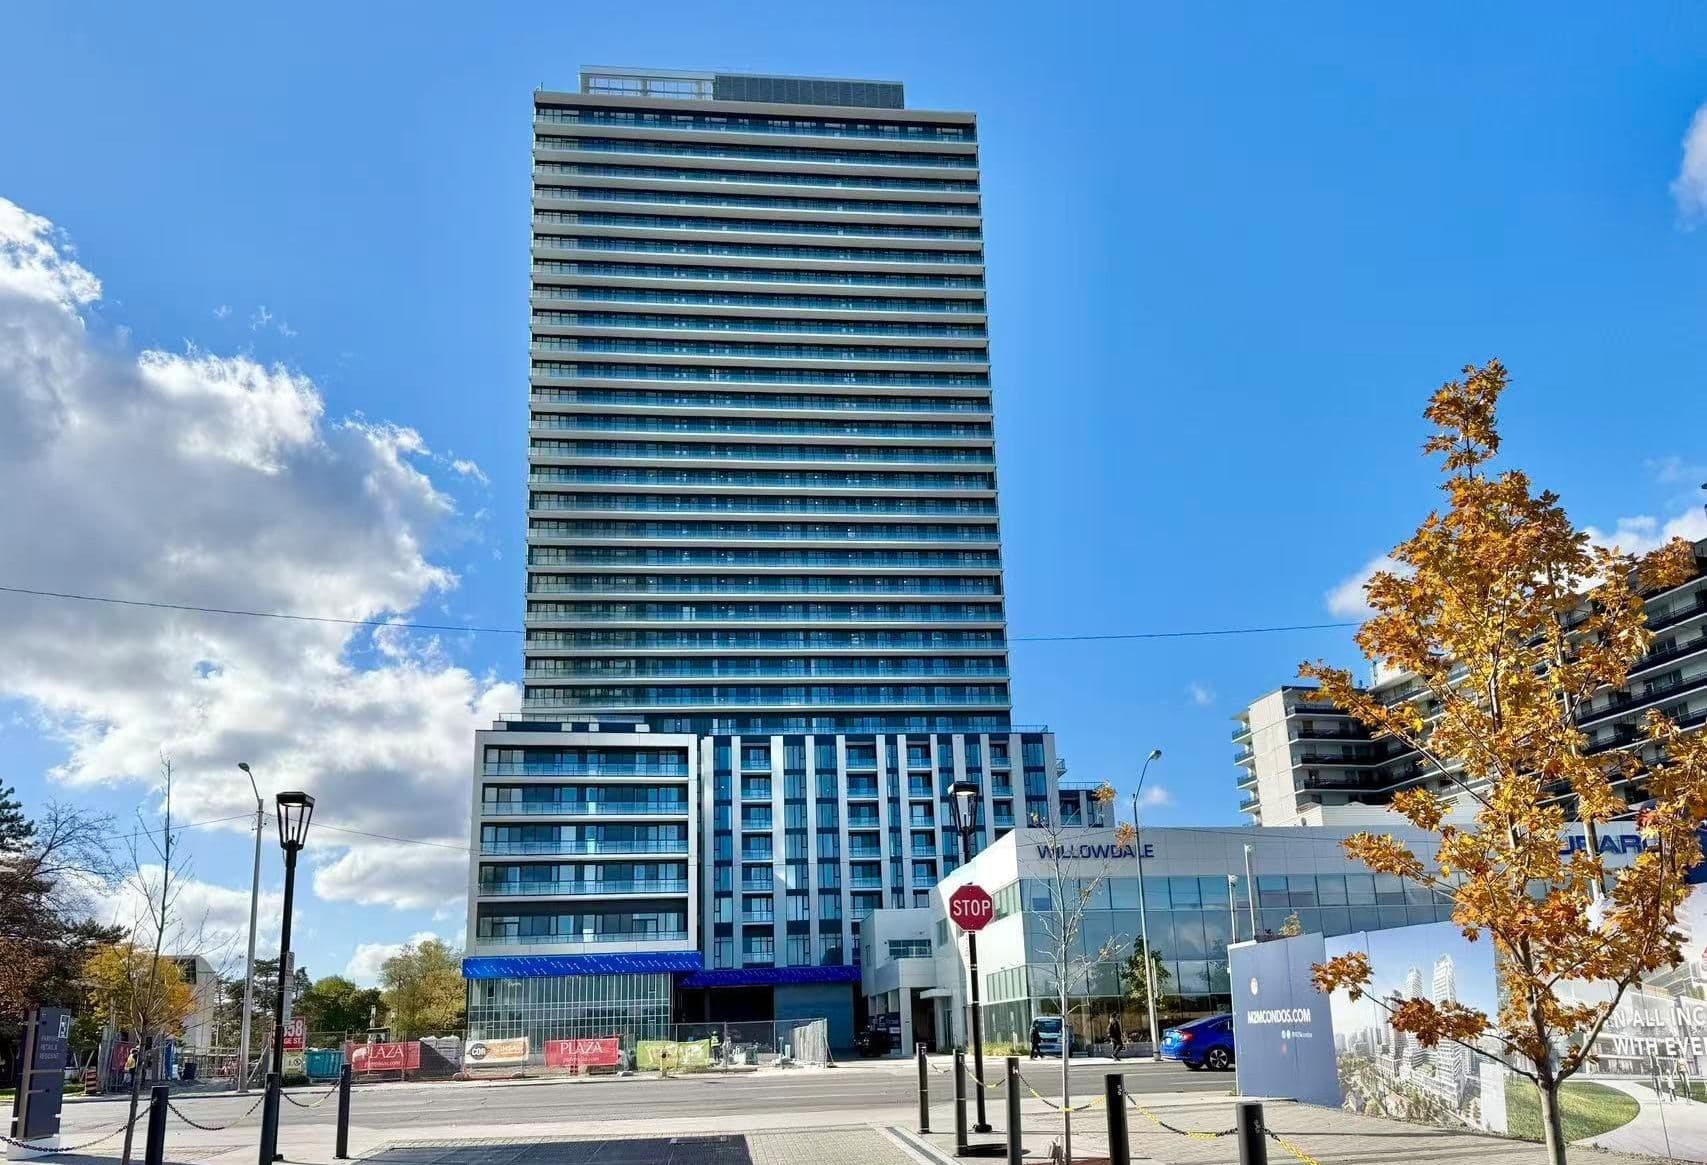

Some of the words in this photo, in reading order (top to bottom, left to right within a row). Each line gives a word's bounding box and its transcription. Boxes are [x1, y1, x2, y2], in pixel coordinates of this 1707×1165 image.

[1037, 844, 1155, 860] WILLOWDALE
[952, 899, 991, 917] STOP
[1247, 1008, 1312, 1025] M2MCONDOS.COM
[1633, 1008, 1665, 1027] ALL
[364, 1044, 405, 1059] LAZA
[560, 1041, 604, 1056] PLAZA
[1613, 1036, 1659, 1056] WITH
